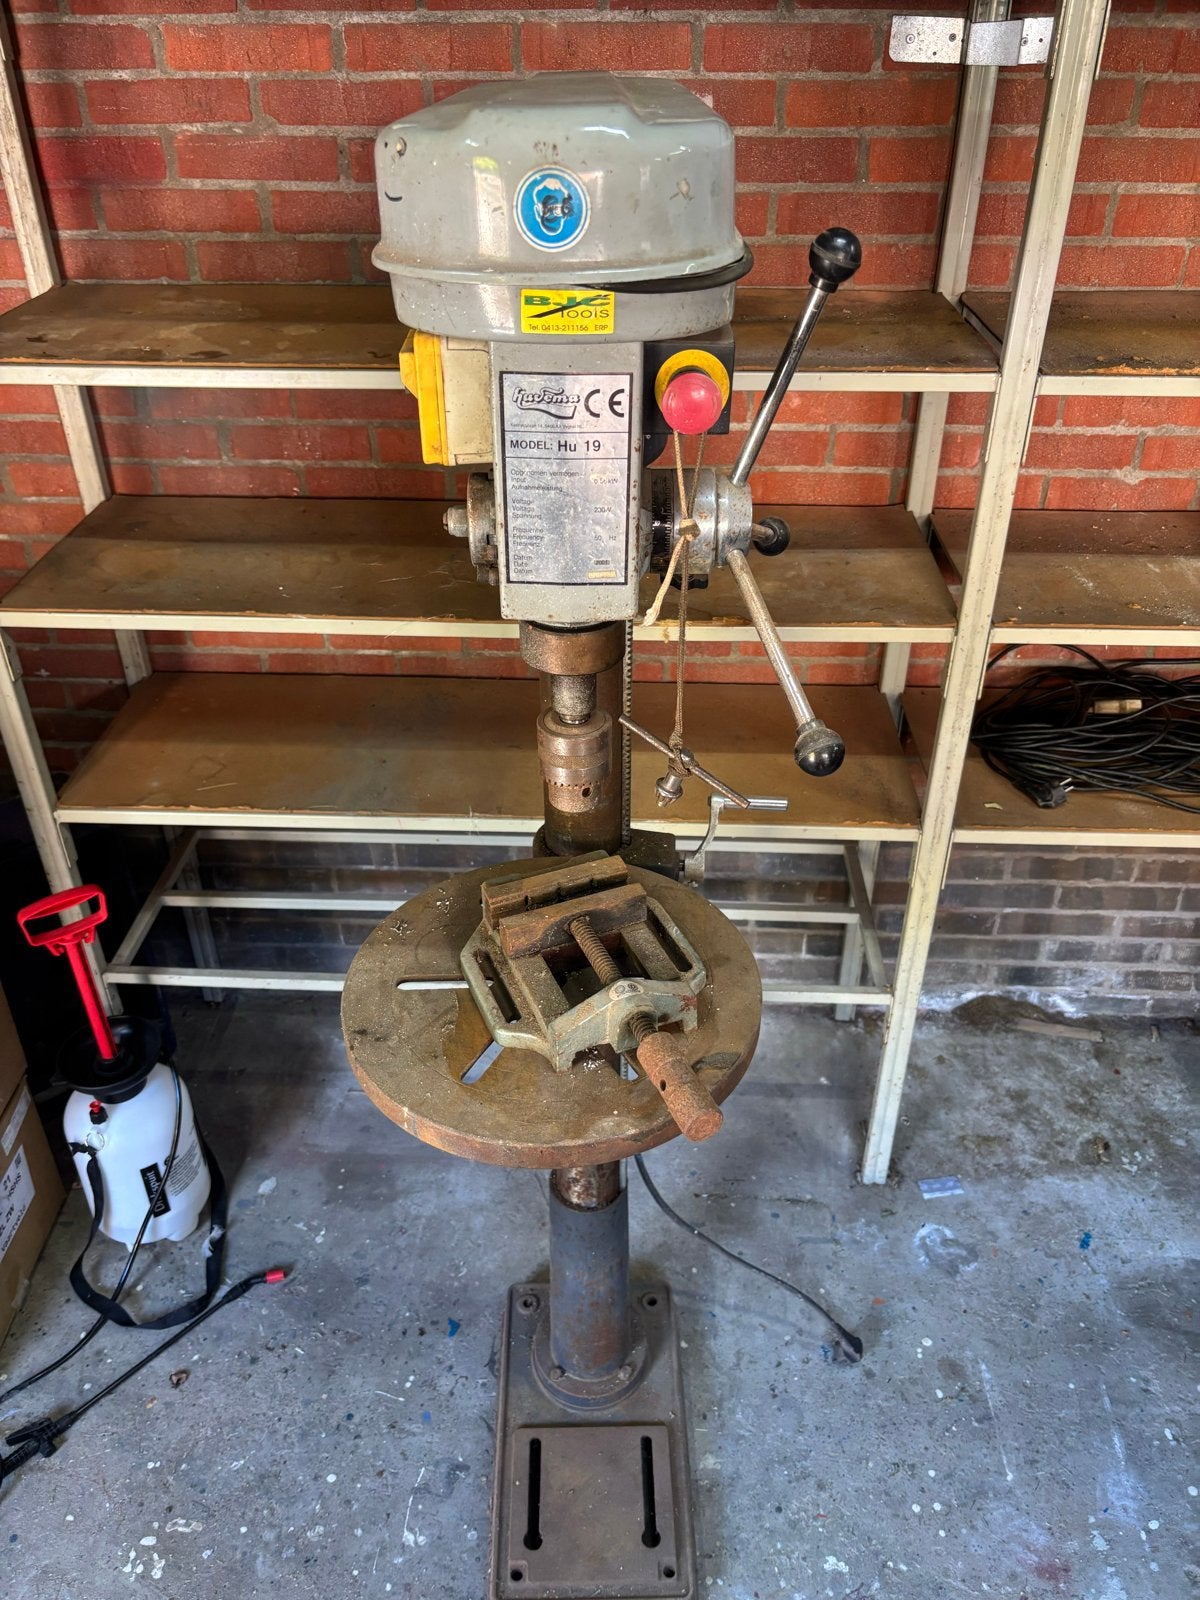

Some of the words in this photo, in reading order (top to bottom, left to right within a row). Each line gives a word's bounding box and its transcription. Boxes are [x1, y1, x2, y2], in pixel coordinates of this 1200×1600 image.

[524, 294, 611, 307] BJC
[583, 388, 625, 418] CE
[510, 440, 553, 450] MODEL:
[557, 440, 577, 452] Hu
[585, 440, 601, 452] 19
[146, 1169, 166, 1213] Drkspuit
